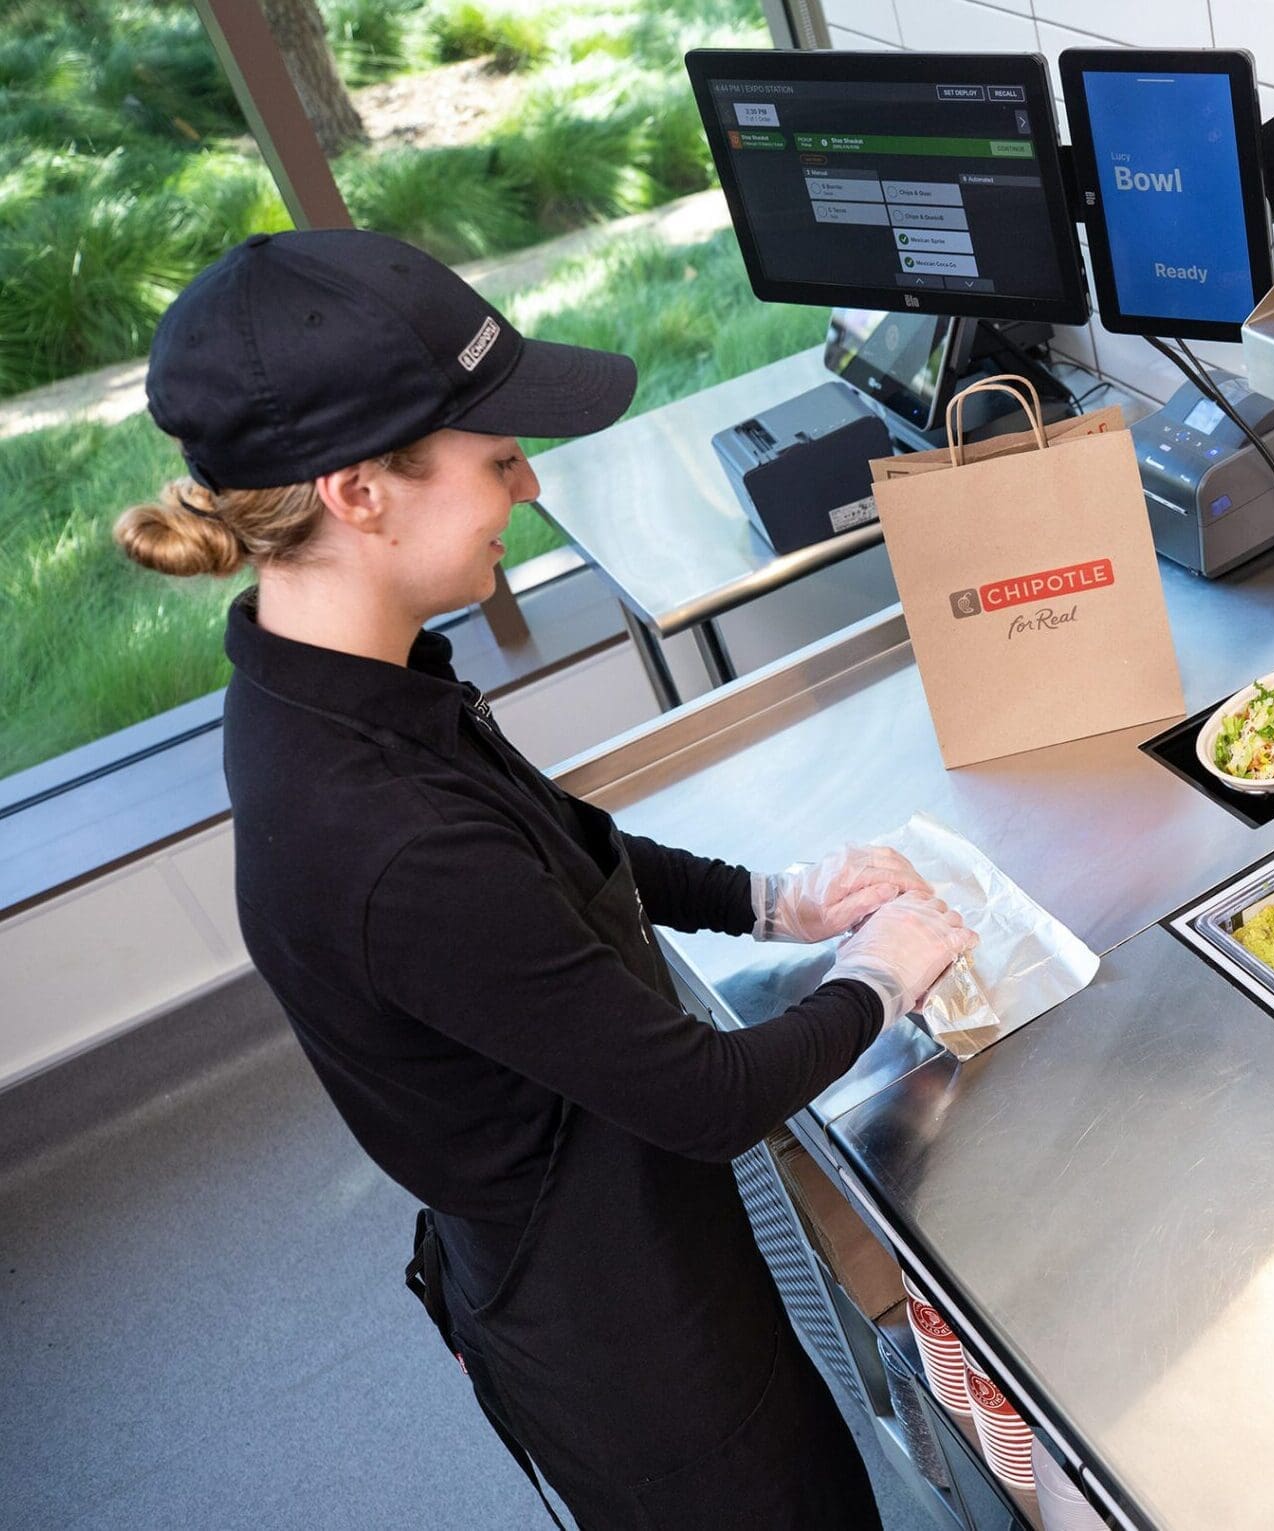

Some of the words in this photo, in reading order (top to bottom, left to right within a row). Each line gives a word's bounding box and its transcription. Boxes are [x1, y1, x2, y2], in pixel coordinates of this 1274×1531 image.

[745, 85, 764, 93] EXPO
[765, 86, 794, 94] STATION
[955, 89, 977, 97] DEPLOY
[1110, 151, 1131, 162] Lucy
[1114, 166, 1183, 193] Bowl
[1155, 263, 1208, 284] Ready
[987, 565, 1108, 605] CHIPOTLE
[1008, 614, 1035, 640] for
[1035, 605, 1079, 631] Real
